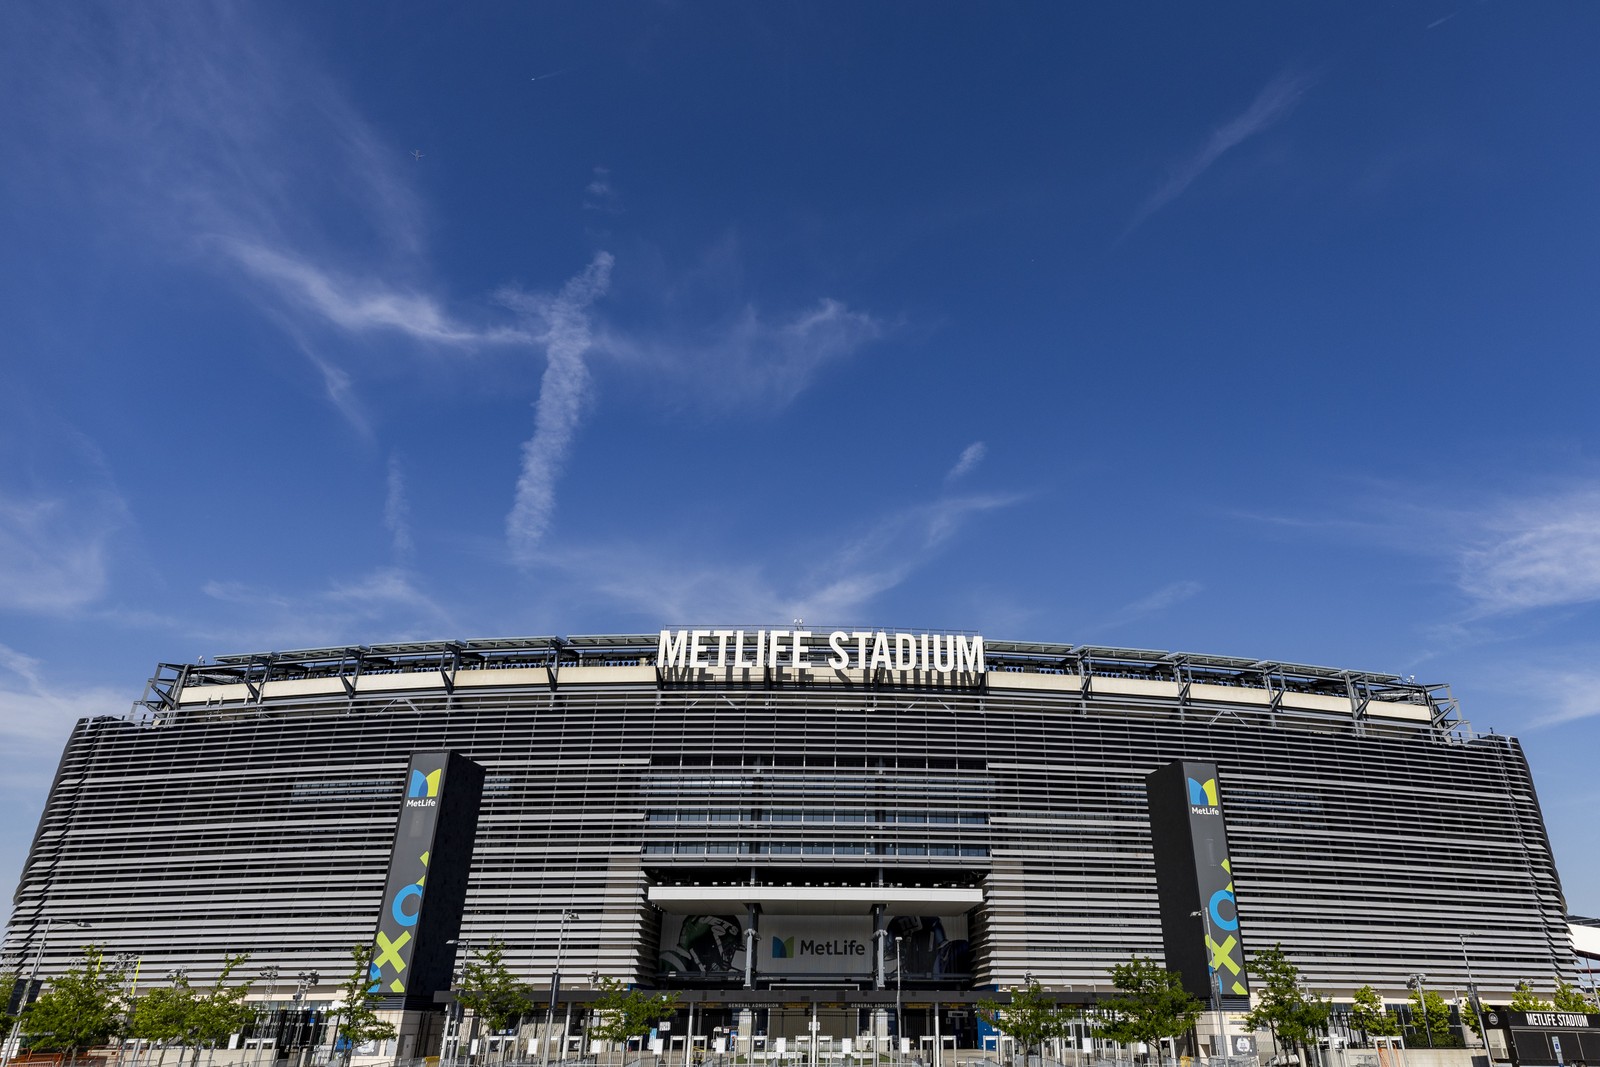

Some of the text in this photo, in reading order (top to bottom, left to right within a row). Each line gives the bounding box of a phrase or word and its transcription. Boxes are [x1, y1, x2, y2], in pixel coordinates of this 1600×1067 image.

[657, 630, 985, 674] METLIFE STADIUM
[406, 799, 436, 807] MetLife
[1191, 807, 1219, 815] MetLife
[800, 940, 865, 955] MetLife
[1526, 1013, 1589, 1027] METLIFE STADIUM
